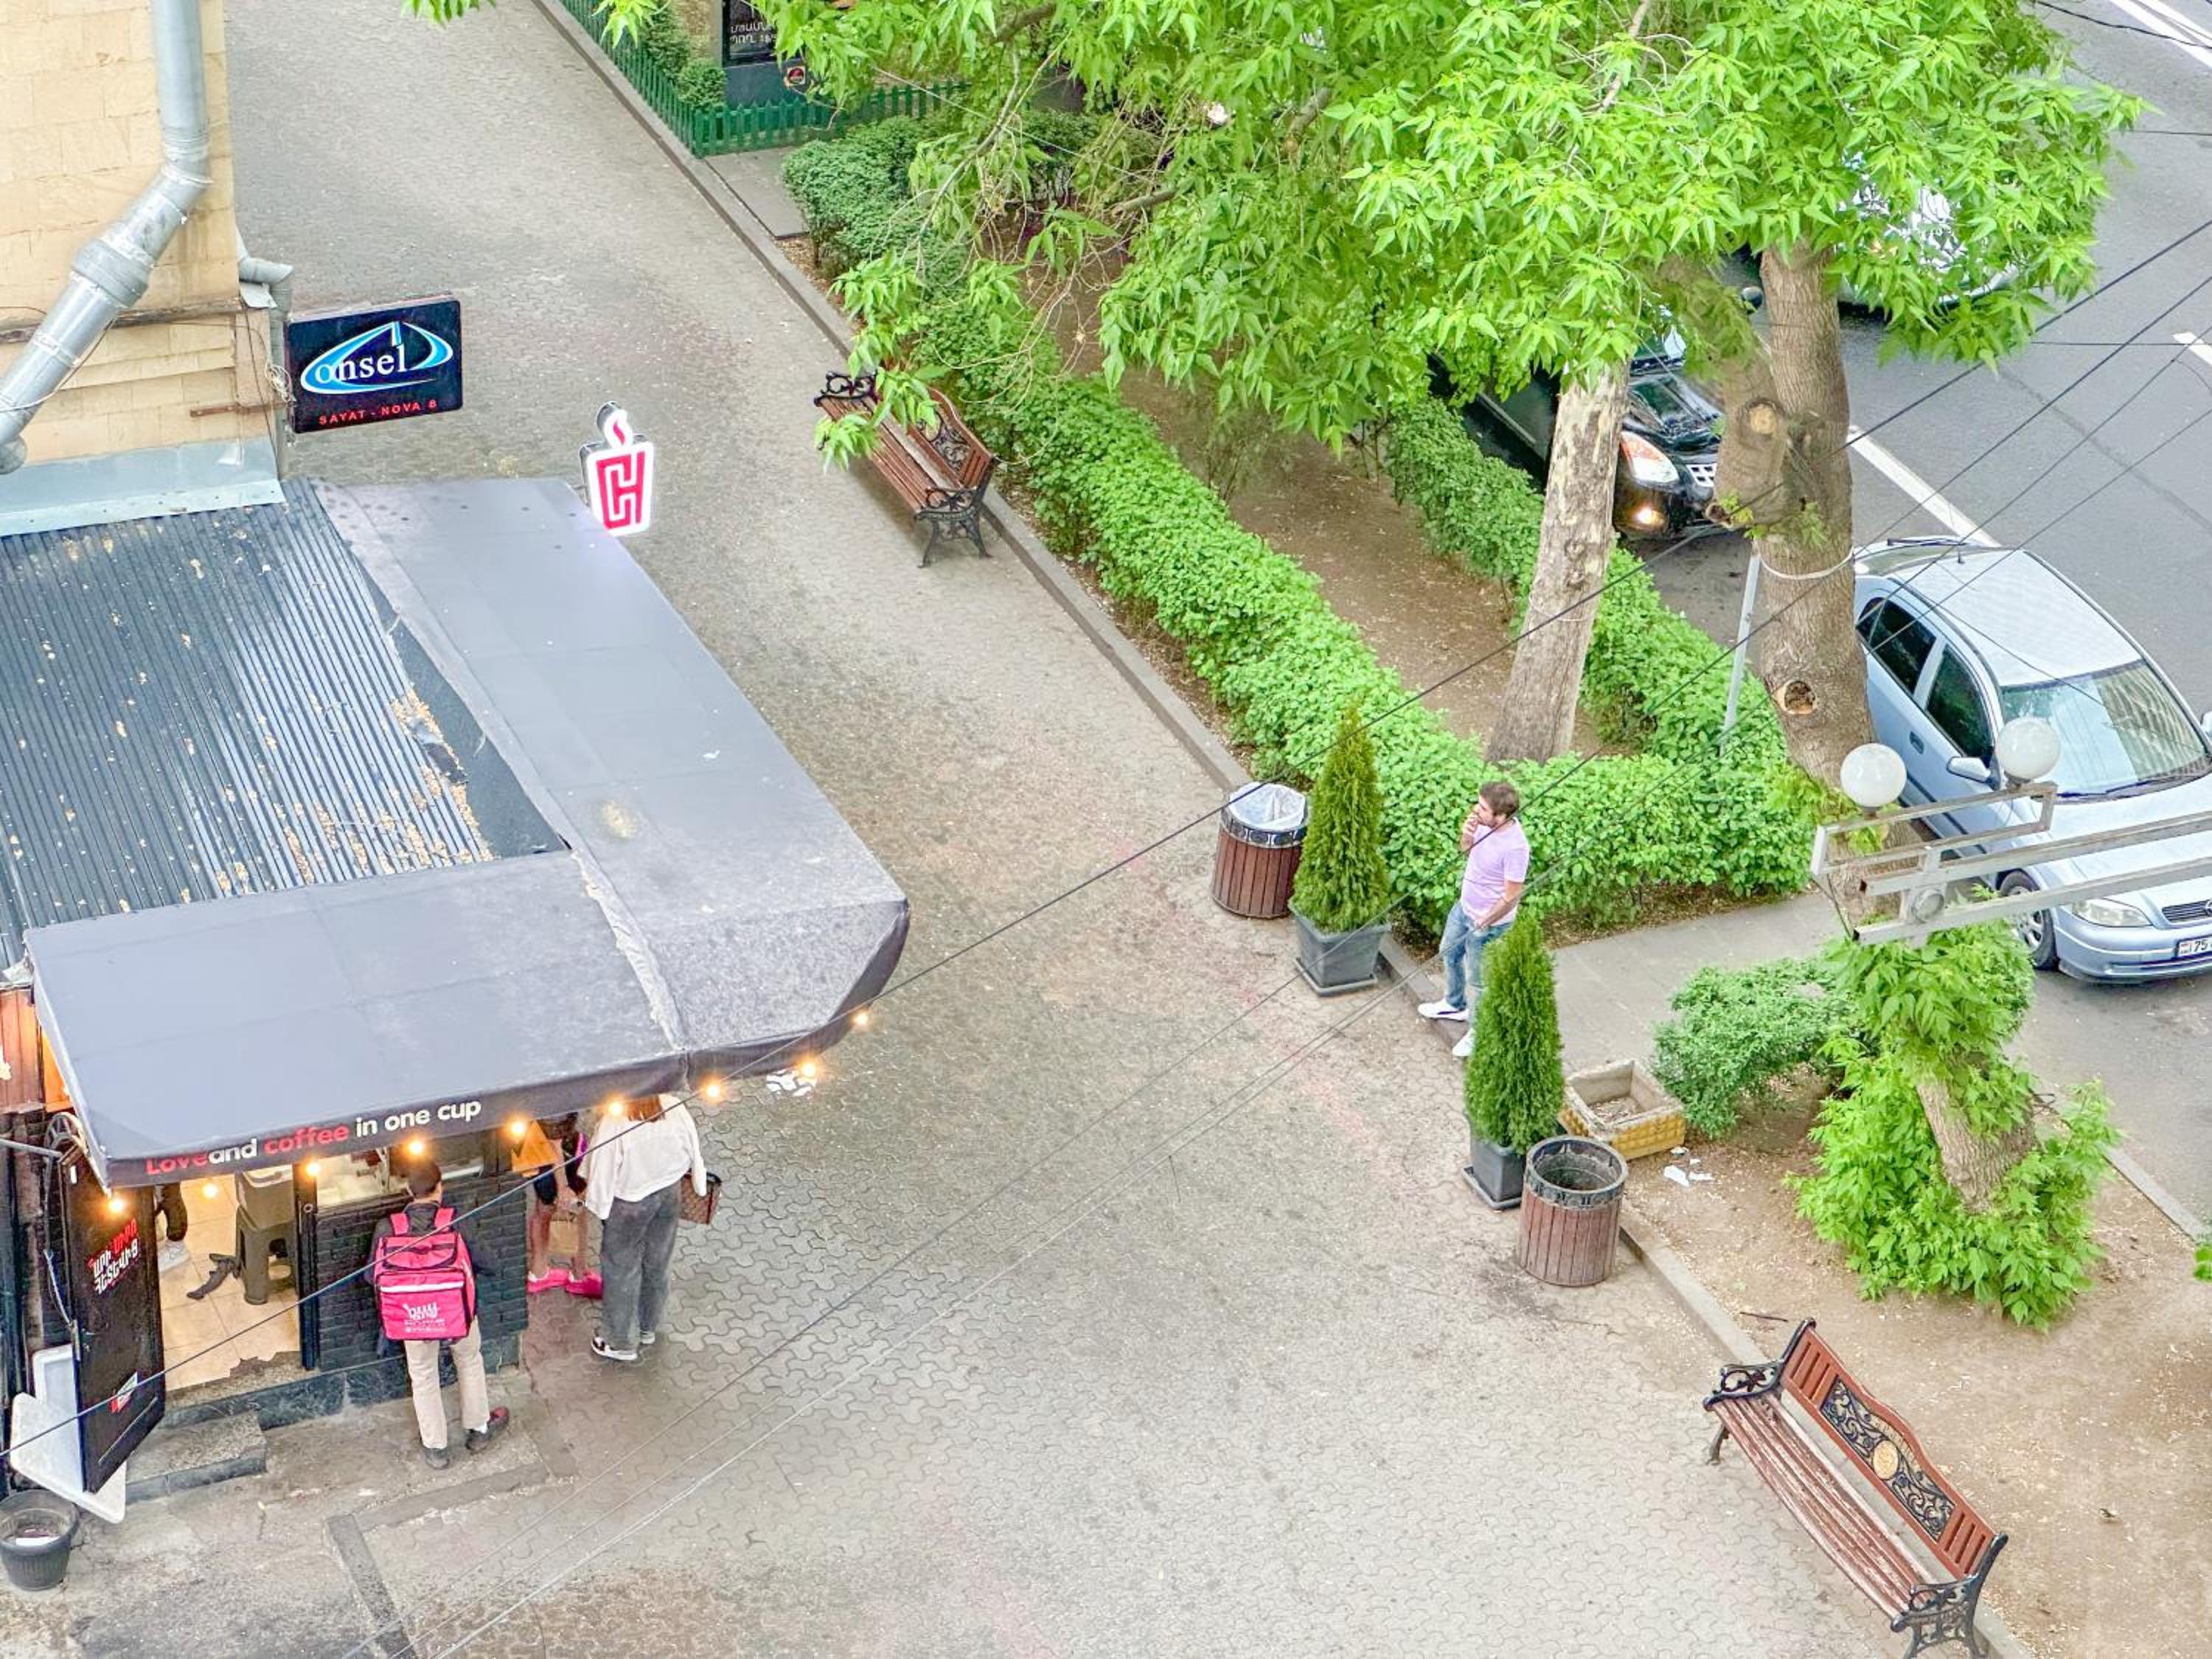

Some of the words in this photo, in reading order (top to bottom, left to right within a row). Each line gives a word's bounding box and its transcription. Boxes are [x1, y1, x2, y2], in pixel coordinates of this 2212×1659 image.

[319, 410, 366, 425] SAYAT
[381, 402, 421, 416] NOVA
[145, 1153, 207, 1175] Love
[208, 1138, 257, 1165] and
[264, 1123, 349, 1155] coffee
[355, 1118, 378, 1138] in
[384, 1110, 431, 1131] one
[437, 1100, 482, 1121] cup
